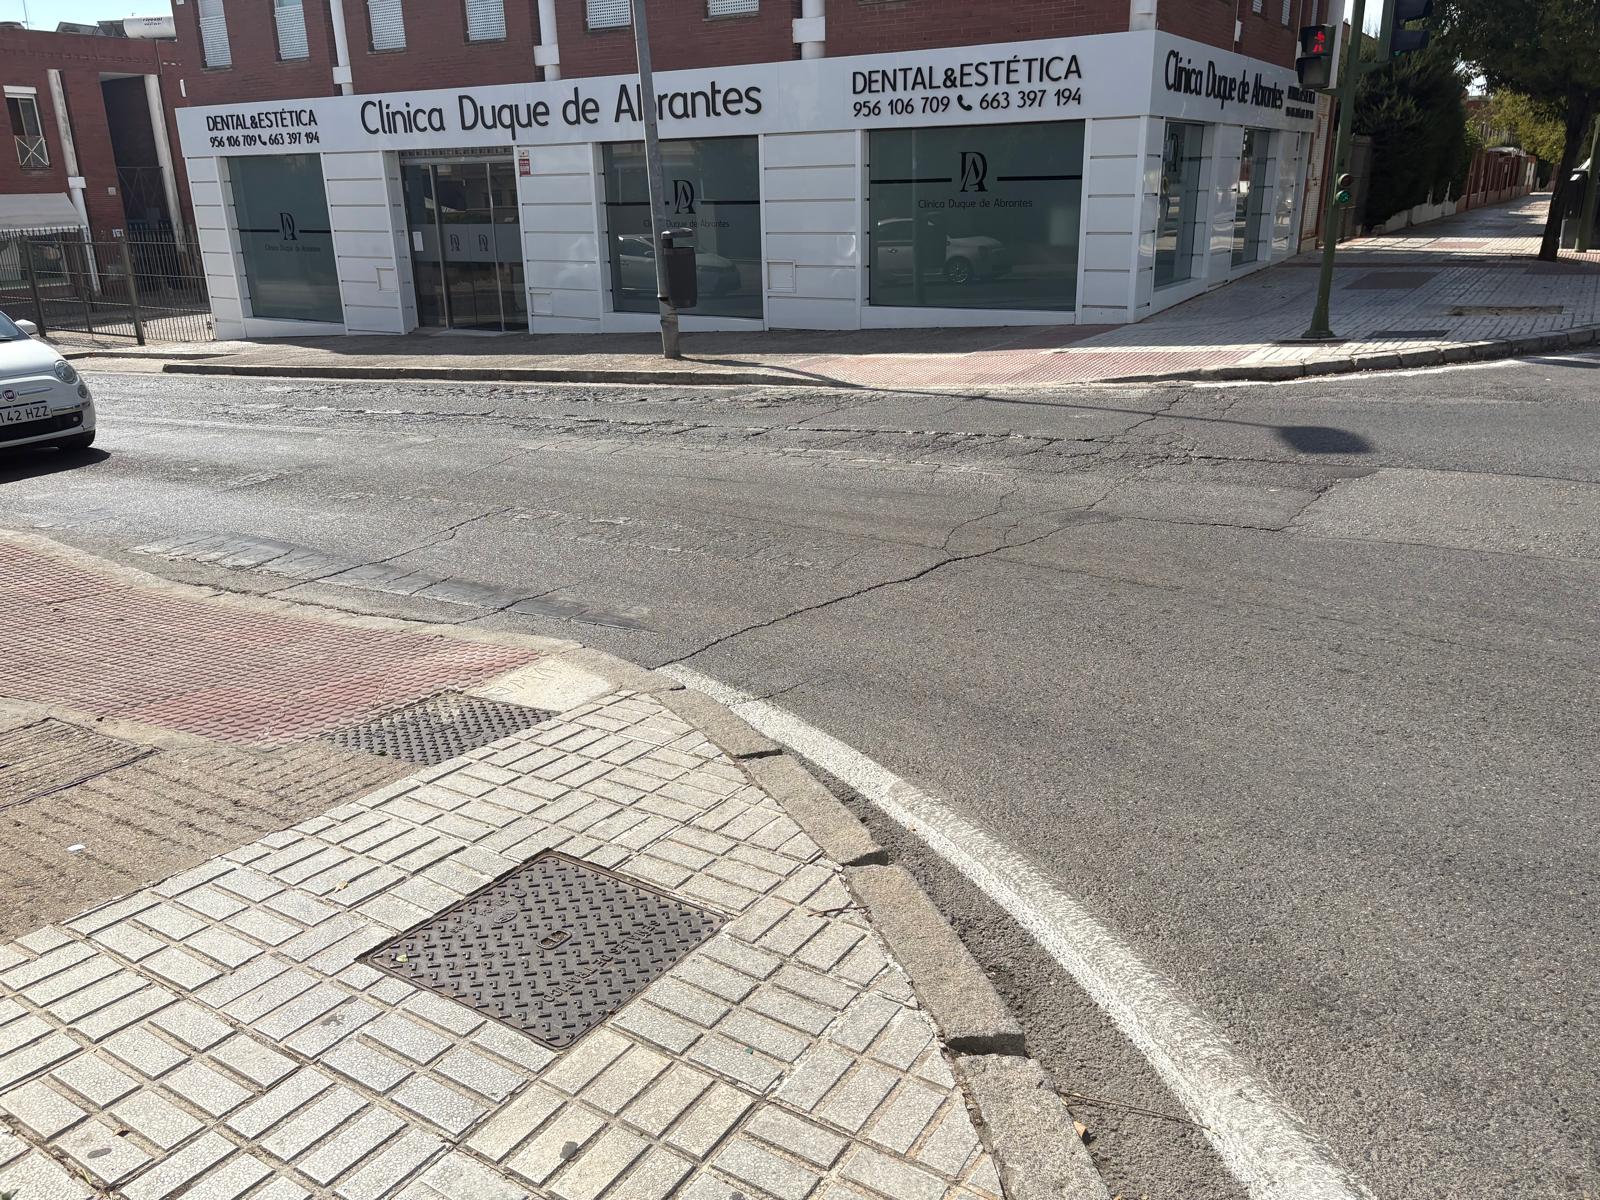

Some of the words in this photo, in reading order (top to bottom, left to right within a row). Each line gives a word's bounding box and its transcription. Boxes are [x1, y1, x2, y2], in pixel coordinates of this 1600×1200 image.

[852, 54, 1083, 95] DENTAL&ESTÉTICA
[1165, 49, 1203, 96] Clínica
[1205, 60, 1237, 110] Duque
[1237, 69, 1250, 104] de
[1250, 72, 1284, 110] Abrantes
[360, 99, 446, 135] Clínica
[457, 94, 550, 141] Duque
[561, 86, 600, 126] de
[852, 99, 882, 118] 956
[887, 97, 915, 116] 106
[920, 95, 951, 115] 709
[979, 91, 1011, 111] 663
[1016, 89, 1047, 109] 397
[1053, 86, 1083, 107] 194
[205, 108, 318, 132] DENTAL&ESTÉTICA
[209, 135, 226, 149] 956
[226, 134, 241, 148] 106
[241, 133, 257, 147] 709
[268, 132, 285, 146] 663
[287, 131, 302, 145] 397
[304, 130, 320, 144] 194
[948, 197, 978, 212] Duque
[979, 197, 991, 209] de
[993, 196, 1033, 209] Abrantes
[25, 405, 49, 420] HZZ
